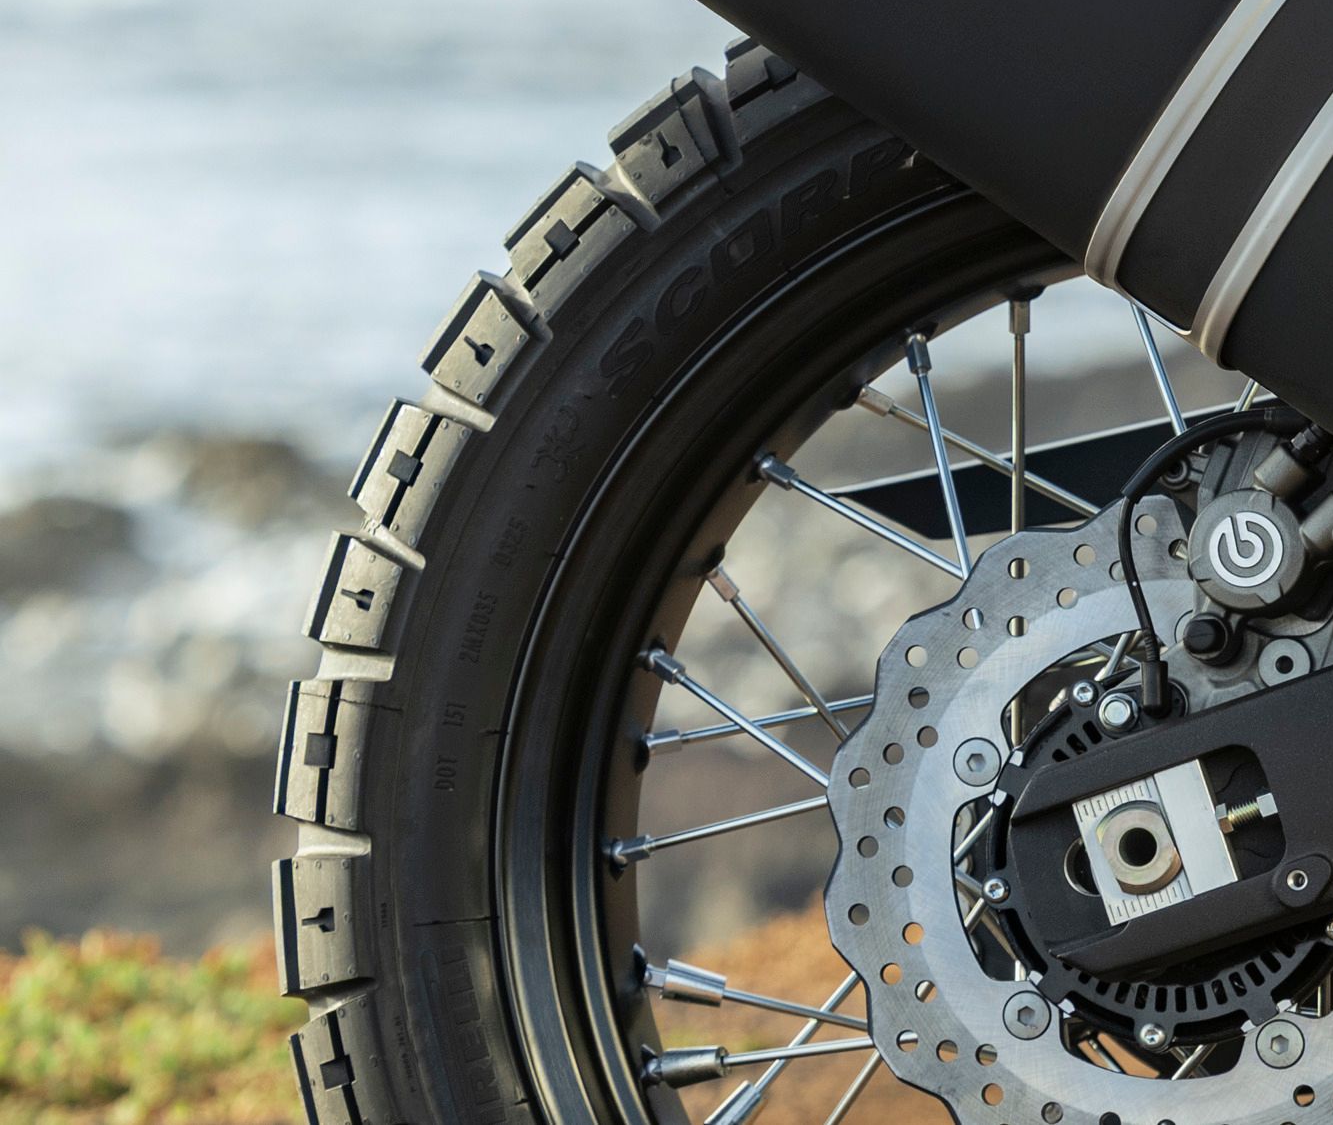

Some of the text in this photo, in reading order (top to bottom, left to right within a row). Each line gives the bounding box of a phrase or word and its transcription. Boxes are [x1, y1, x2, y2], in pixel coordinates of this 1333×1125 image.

[600, 137, 915, 399] SCORP
[433, 755, 458, 791] DOT
[440, 945, 506, 1125] IRELLI
